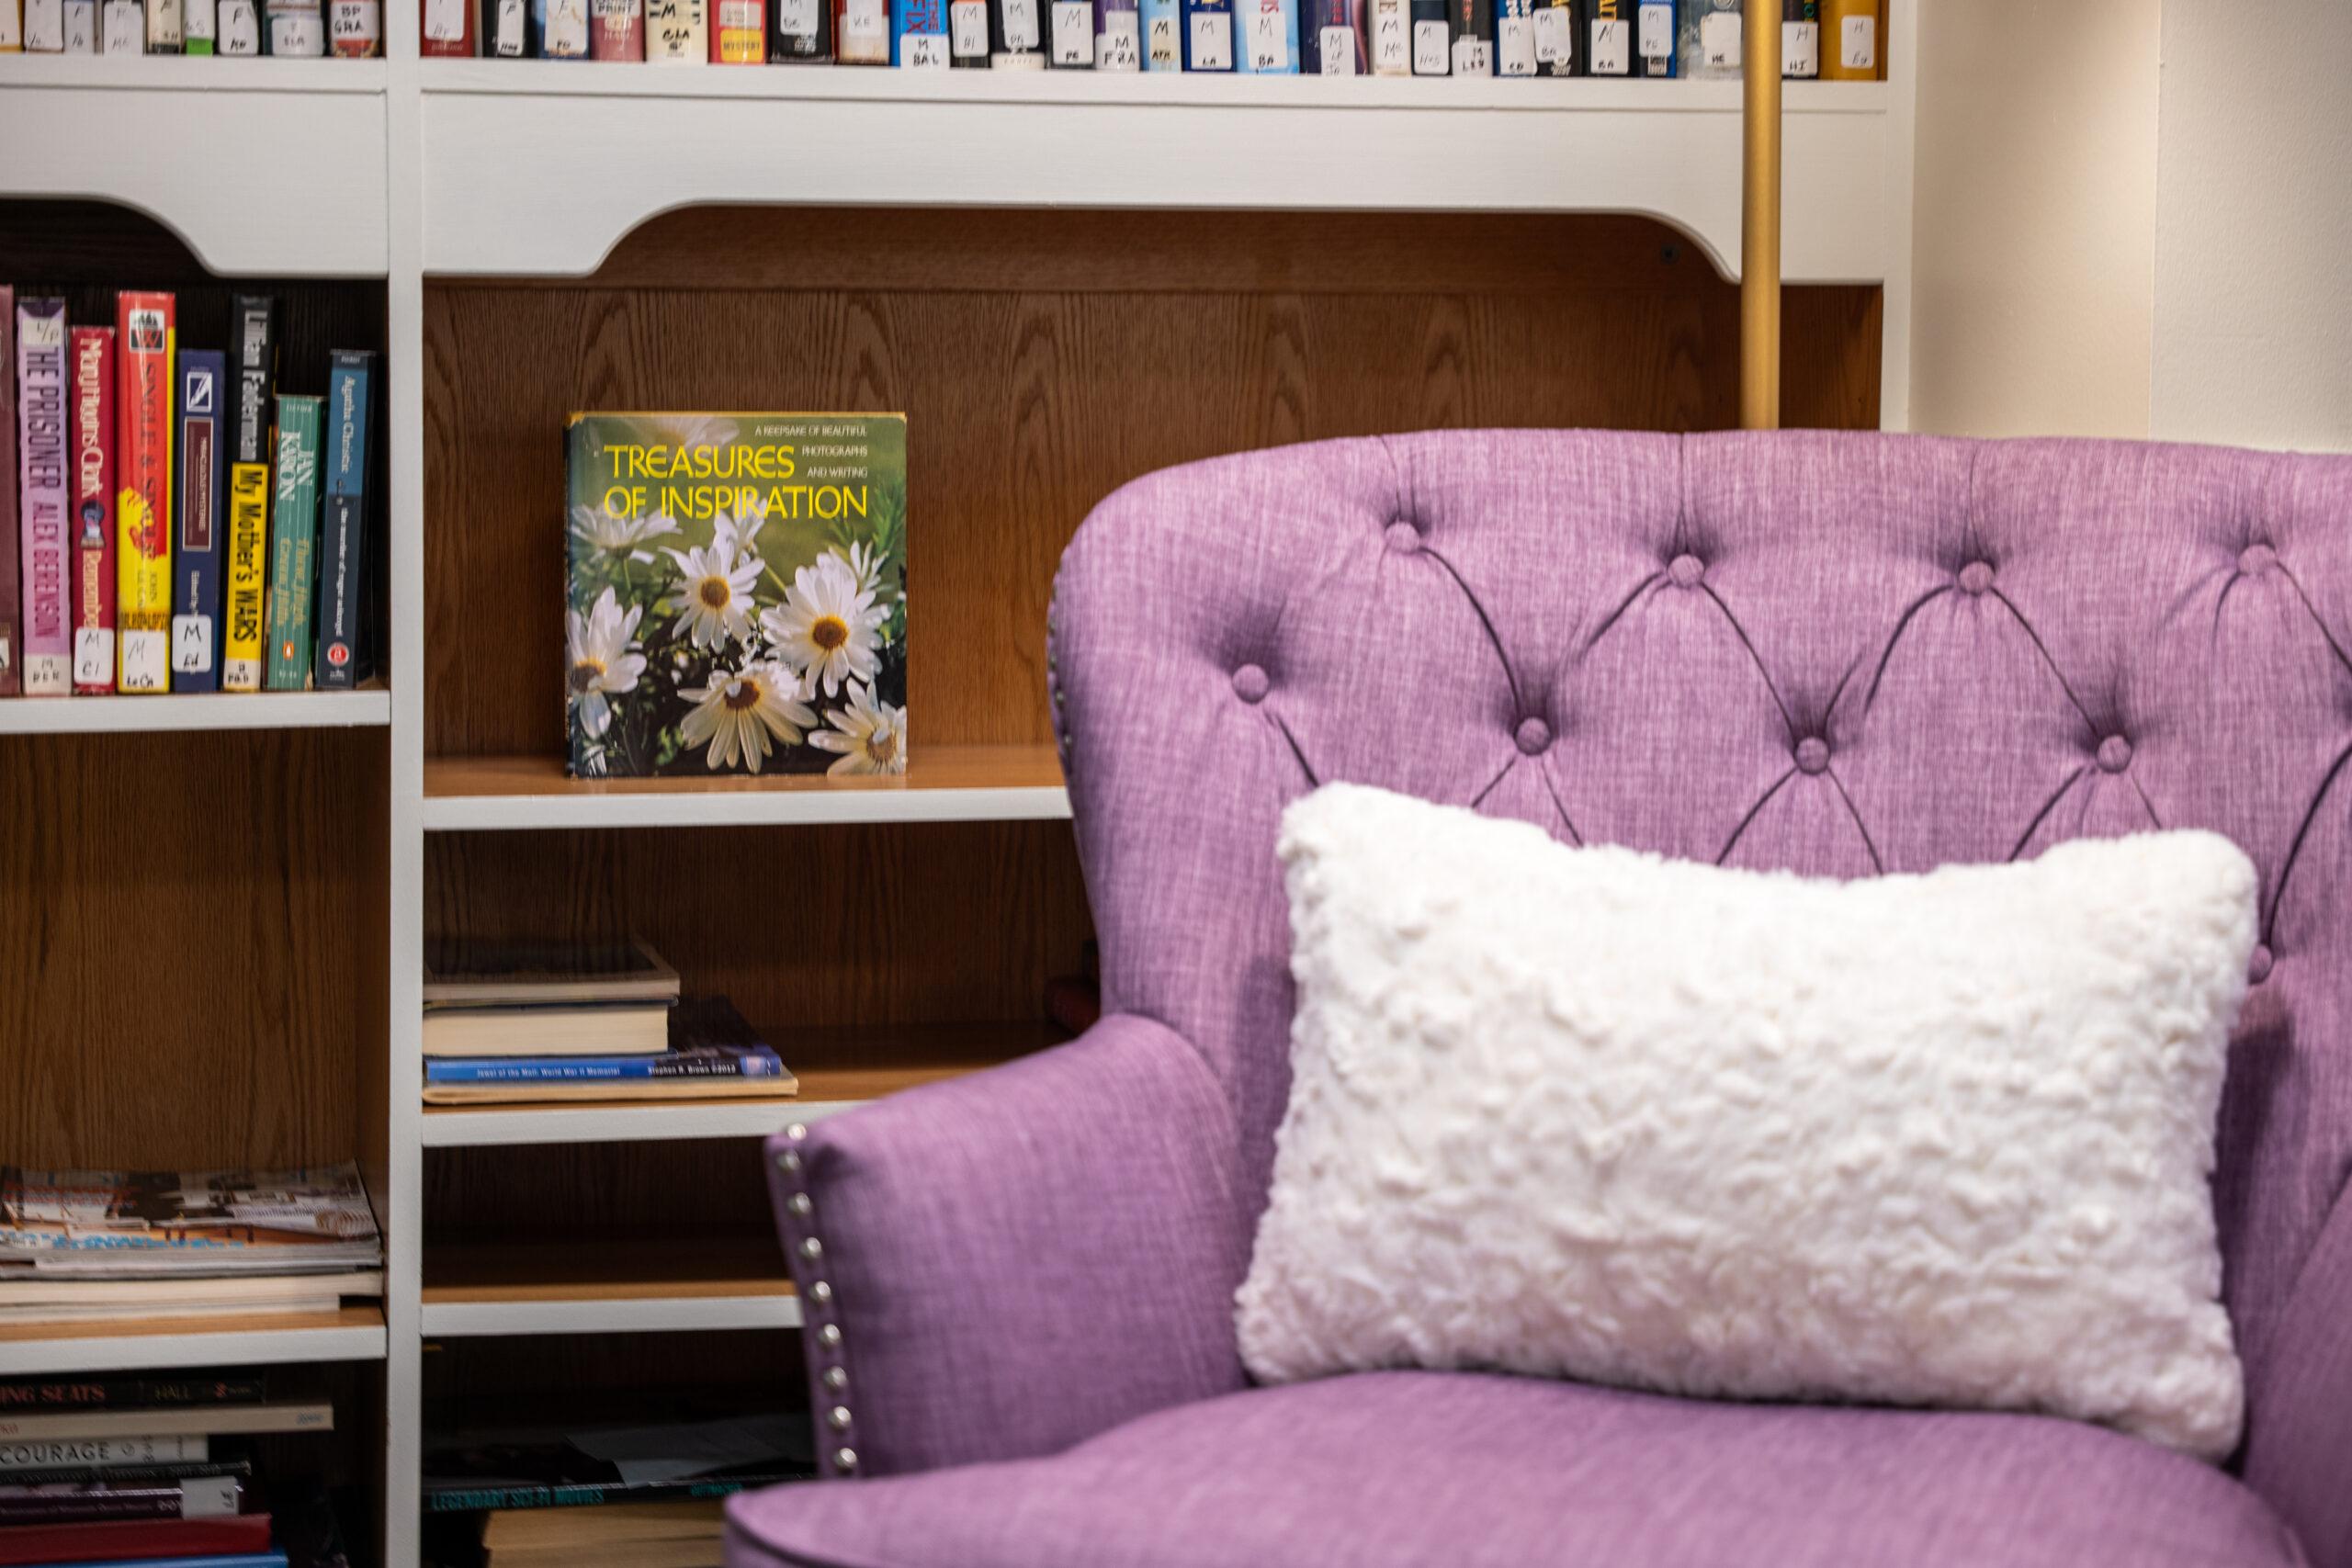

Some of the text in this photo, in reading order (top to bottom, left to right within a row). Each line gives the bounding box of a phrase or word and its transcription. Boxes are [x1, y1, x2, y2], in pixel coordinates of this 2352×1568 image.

[662, 5, 675, 18] M
[963, 6, 977, 19] M
[1066, 8, 1080, 28] M
[1155, 21, 1169, 36] M
[1201, 20, 1215, 34] M
[1260, 18, 1272, 37] M
[723, 41, 763, 52] MYSTERY
[243, 310, 267, 367] Lillian
[141, 362, 156, 445] SINGLE
[27, 347, 61, 488] HE PRISONER
[78, 338, 104, 499] Mary Higgins Clark
[240, 370, 266, 461] Faderman
[341, 375, 356, 473] Agatha Christie
[763, 425, 808, 436] KEEPSAKE
[808, 425, 820, 436] OF
[821, 425, 867, 436] BEAUTIFUL
[604, 445, 795, 479] TREASURES
[801, 446, 868, 457] PHOTOGRAPHS
[279, 431, 300, 502] KARON
[297, 450, 313, 487] JAN
[807, 466, 868, 479] AND WRITING
[604, 485, 868, 520] OF INSPIRATION
[234, 468, 263, 642] My Mother's WARS
[33, 501, 60, 637] ALEX BERENSON
[83, 549, 102, 628] Remembe
[185, 624, 201, 641] M
[129, 640, 145, 661] M
[477, 1067, 497, 1078] Jewel
[507, 1067, 520, 1077] the
[540, 1066, 562, 1077] World
[563, 1066, 578, 1077] War
[586, 1065, 620, 1077] Memorial
[648, 1064, 677, 1076] Stephen
[688, 1064, 710, 1075] Brown
[0, 1383, 105, 1403] ING SEATS
[0, 1441, 111, 1465] COURAGE
[431, 1490, 504, 1512] LEGENDARY
[555, 1485, 605, 1505] MOVIES
